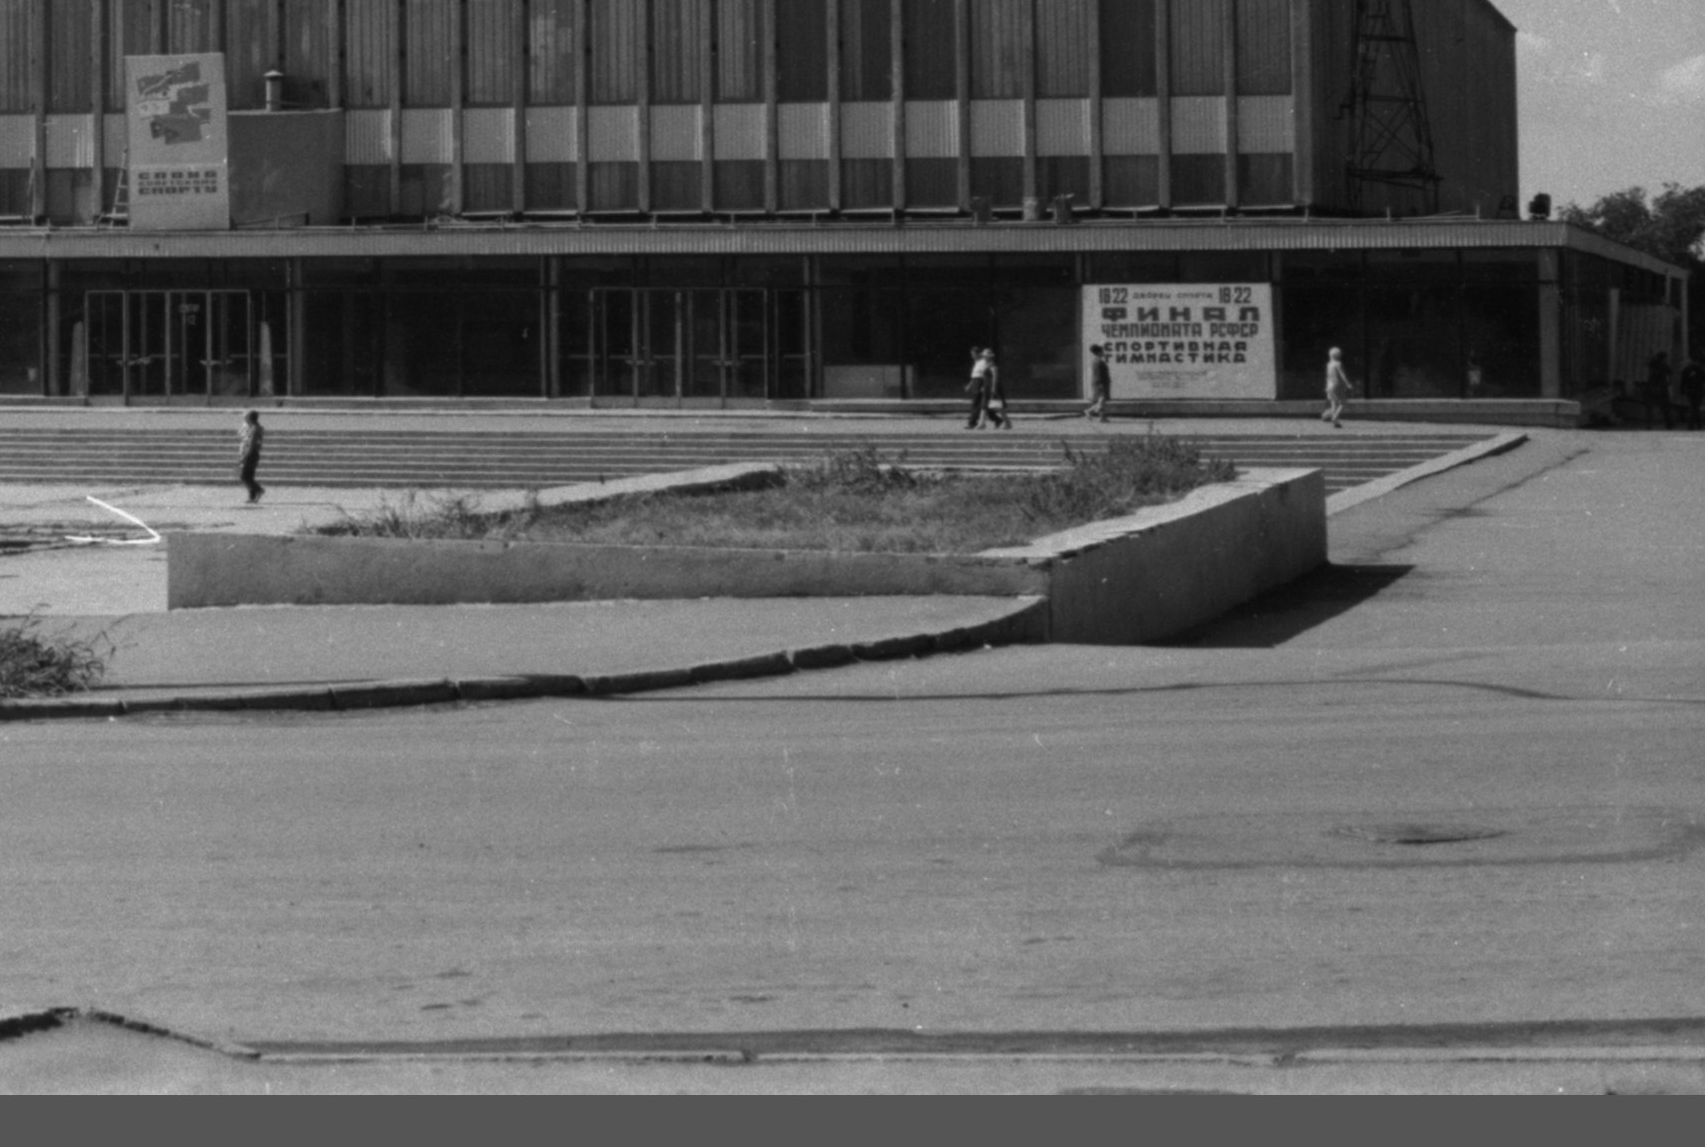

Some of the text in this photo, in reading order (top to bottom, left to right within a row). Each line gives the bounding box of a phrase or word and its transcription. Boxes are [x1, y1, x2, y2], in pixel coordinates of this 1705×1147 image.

[1102, 307, 1260, 321] ФИНАЛ
[1102, 323, 1259, 338] ЧЕМПИОНАТА РСФСР
[1104, 341, 1247, 352] СПОРТИВНАЯ
[1104, 354, 1246, 363] ГИМНАСТИКА
